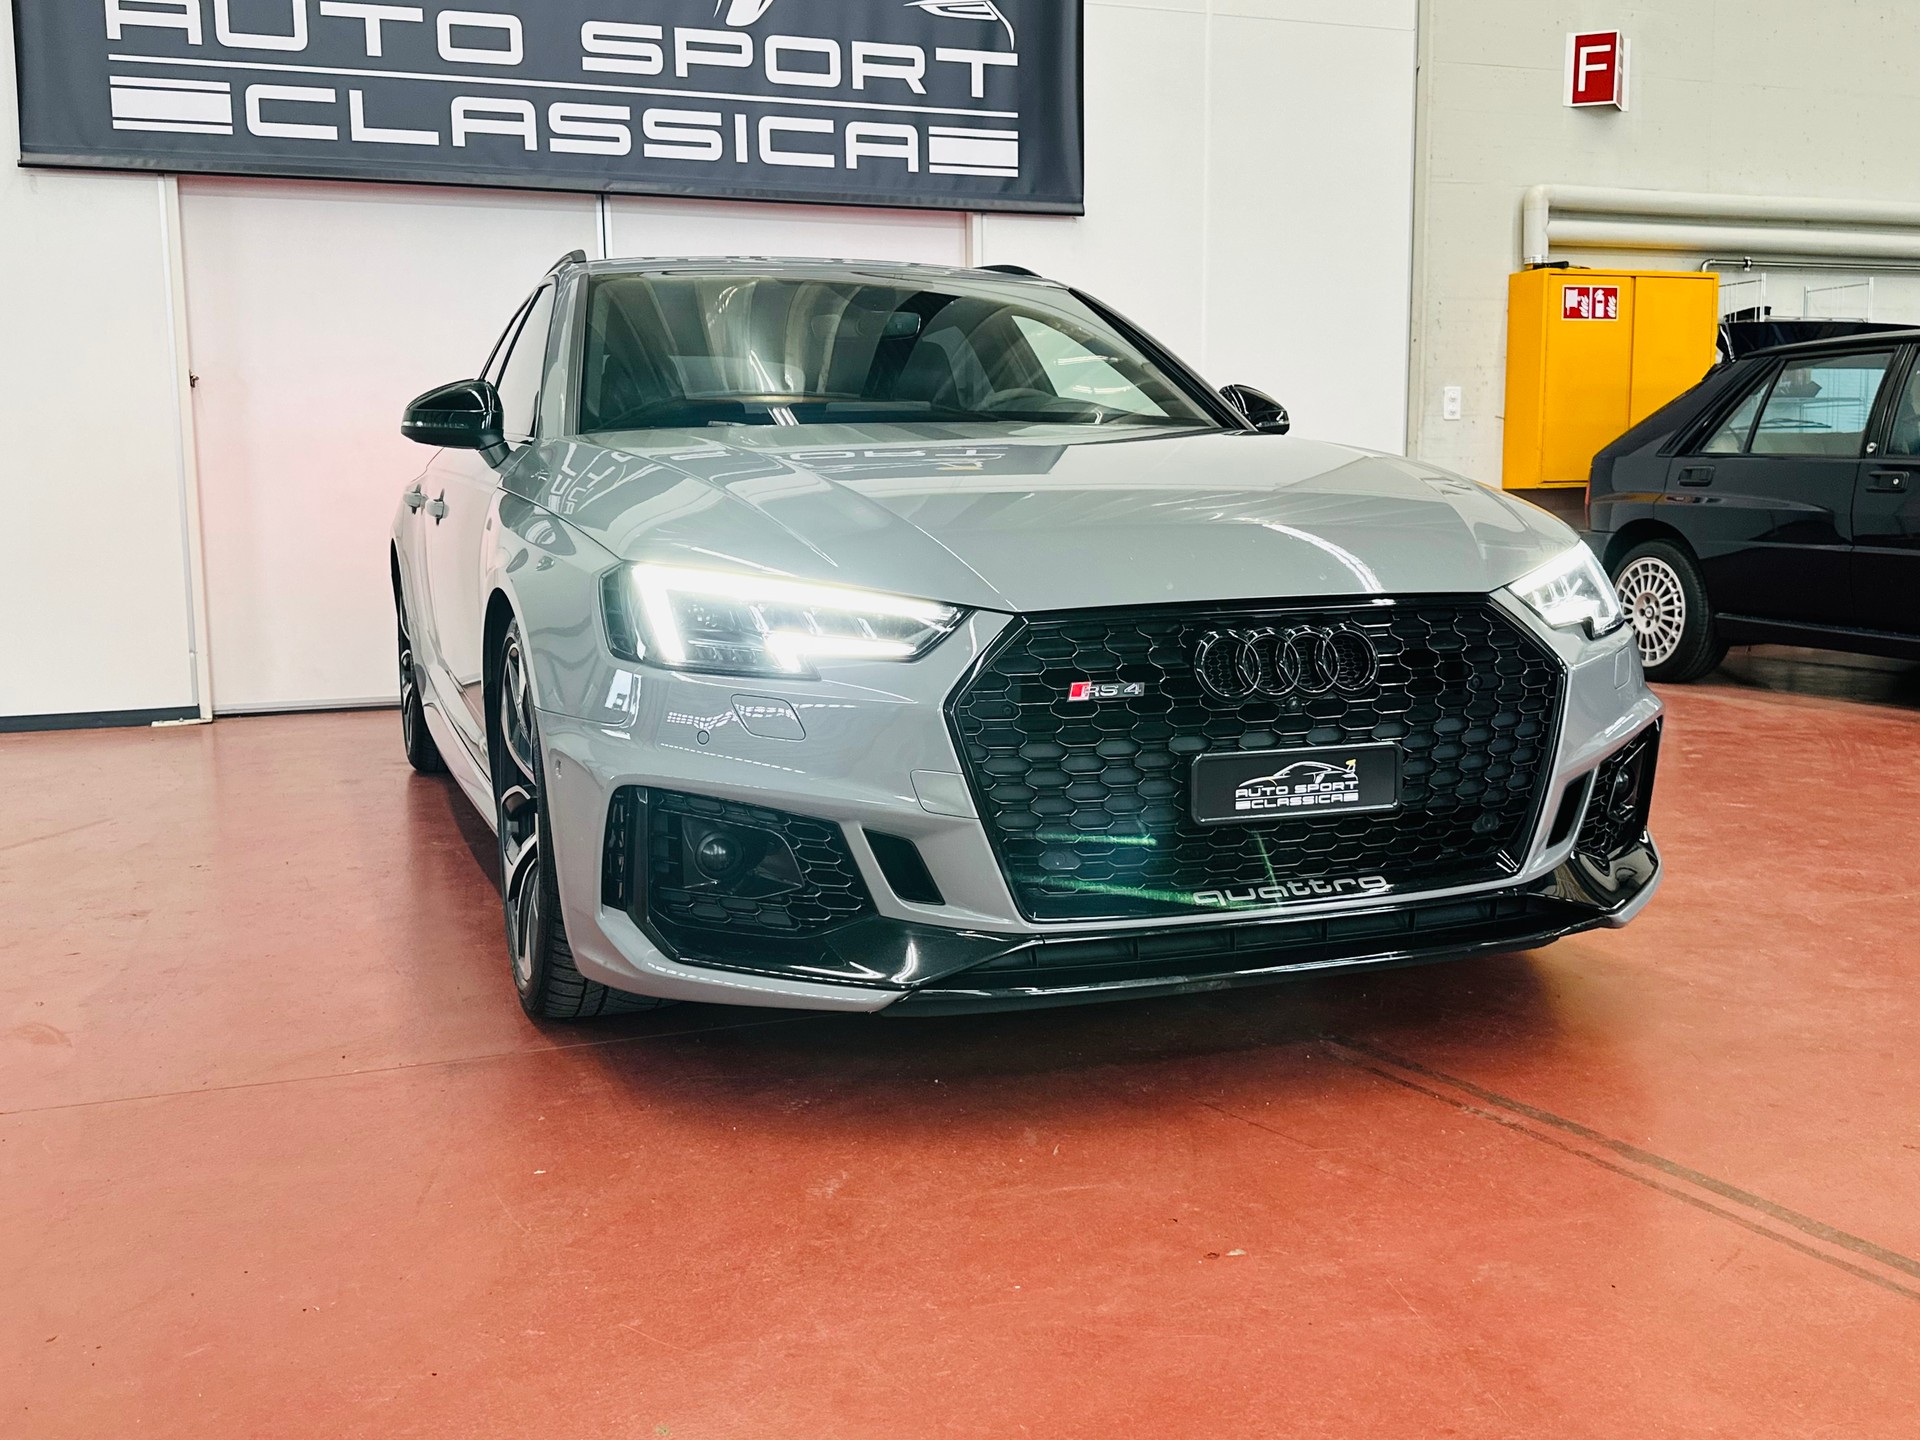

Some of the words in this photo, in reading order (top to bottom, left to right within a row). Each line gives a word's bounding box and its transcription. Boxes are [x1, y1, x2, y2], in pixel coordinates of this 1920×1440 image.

[105, 0, 523, 65] AUTO
[580, 20, 1018, 98] SPORT
[1577, 44, 1611, 92] F
[245, 83, 919, 173] CLASSICA
[1081, 685, 1119, 697] RS
[1123, 683, 1142, 695] 4
[1235, 786, 1288, 798] AUTO
[1294, 781, 1359, 793] SPORT
[1251, 792, 1344, 809] CLASSICA
[1193, 875, 1388, 906] quattro
